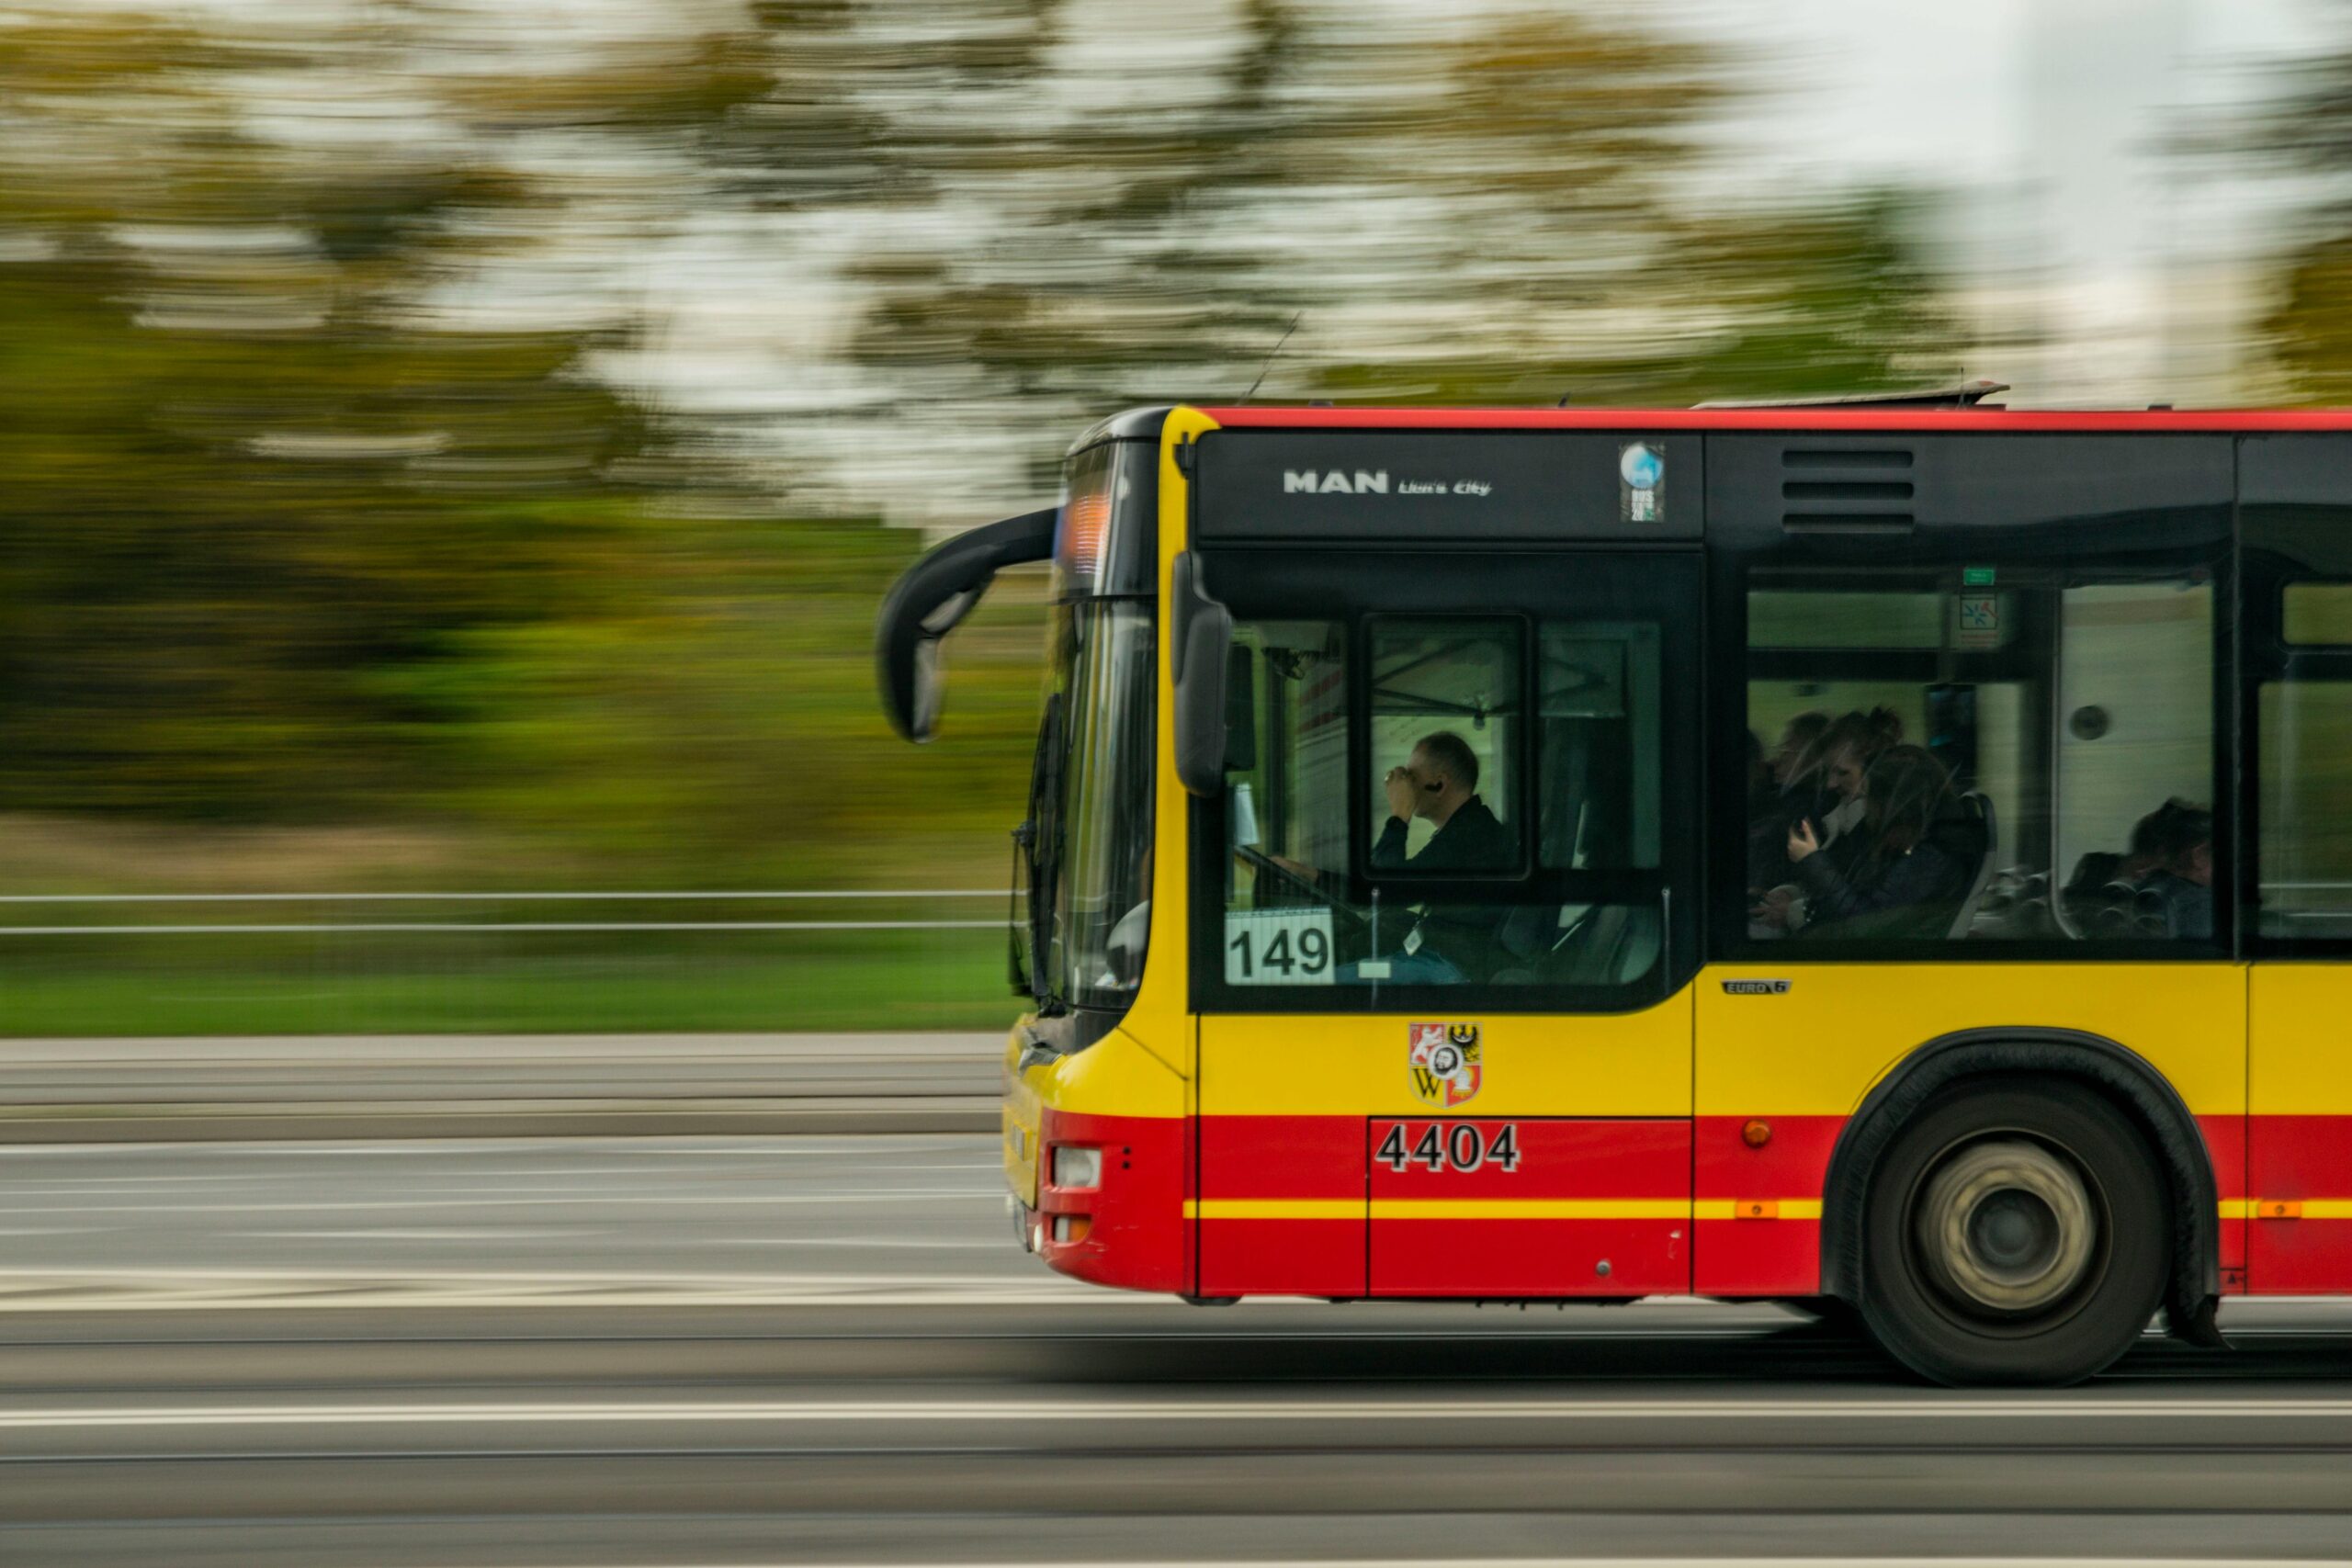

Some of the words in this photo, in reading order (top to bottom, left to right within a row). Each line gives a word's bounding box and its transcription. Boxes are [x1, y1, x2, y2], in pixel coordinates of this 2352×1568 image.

[1284, 469, 1388, 493] MAN
[1453, 479, 1492, 496] City
[1229, 928, 1329, 977] 149
[1726, 982, 1767, 993] EURO
[1774, 981, 1787, 993] 6
[1374, 1123, 1521, 1173] 4404
